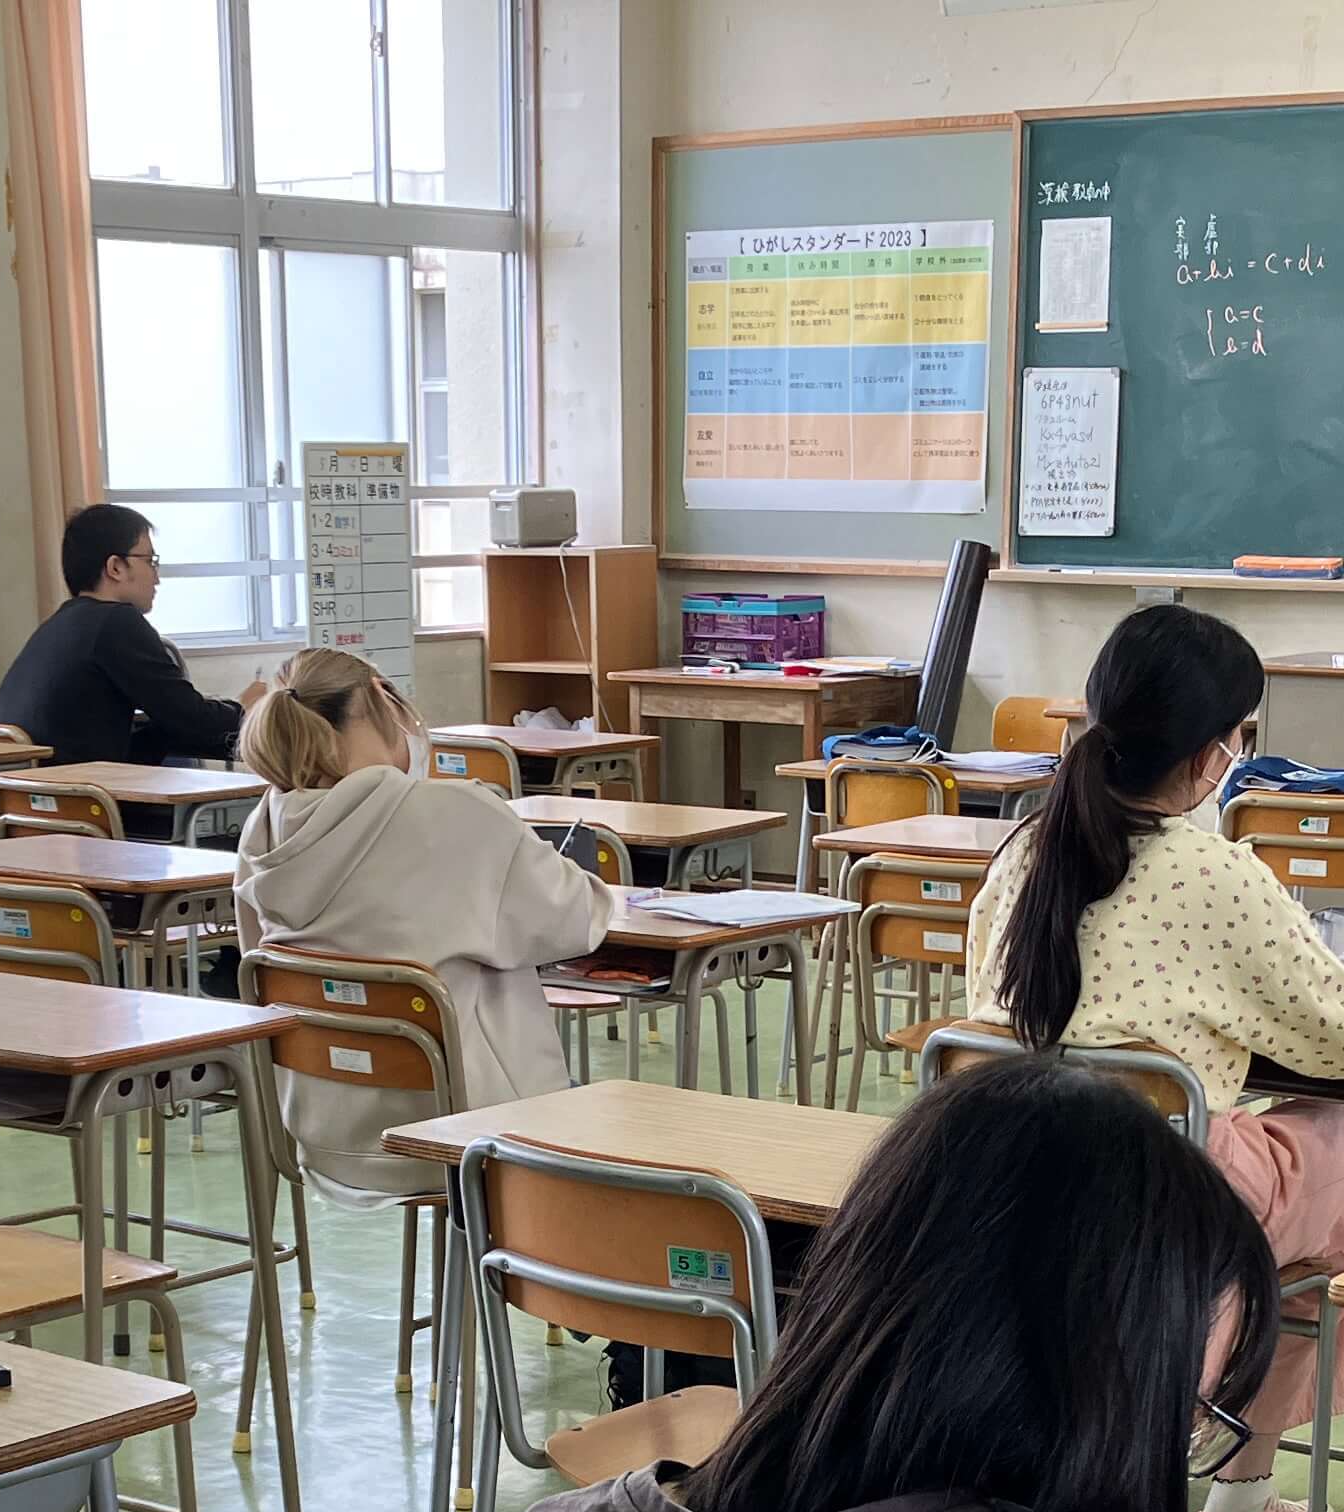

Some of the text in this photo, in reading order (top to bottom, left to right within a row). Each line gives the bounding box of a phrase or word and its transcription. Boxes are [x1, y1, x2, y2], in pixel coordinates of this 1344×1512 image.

[312, 601, 336, 617] SHR
[322, 630, 329, 644] 5
[678, 1256, 689, 1270] 5
